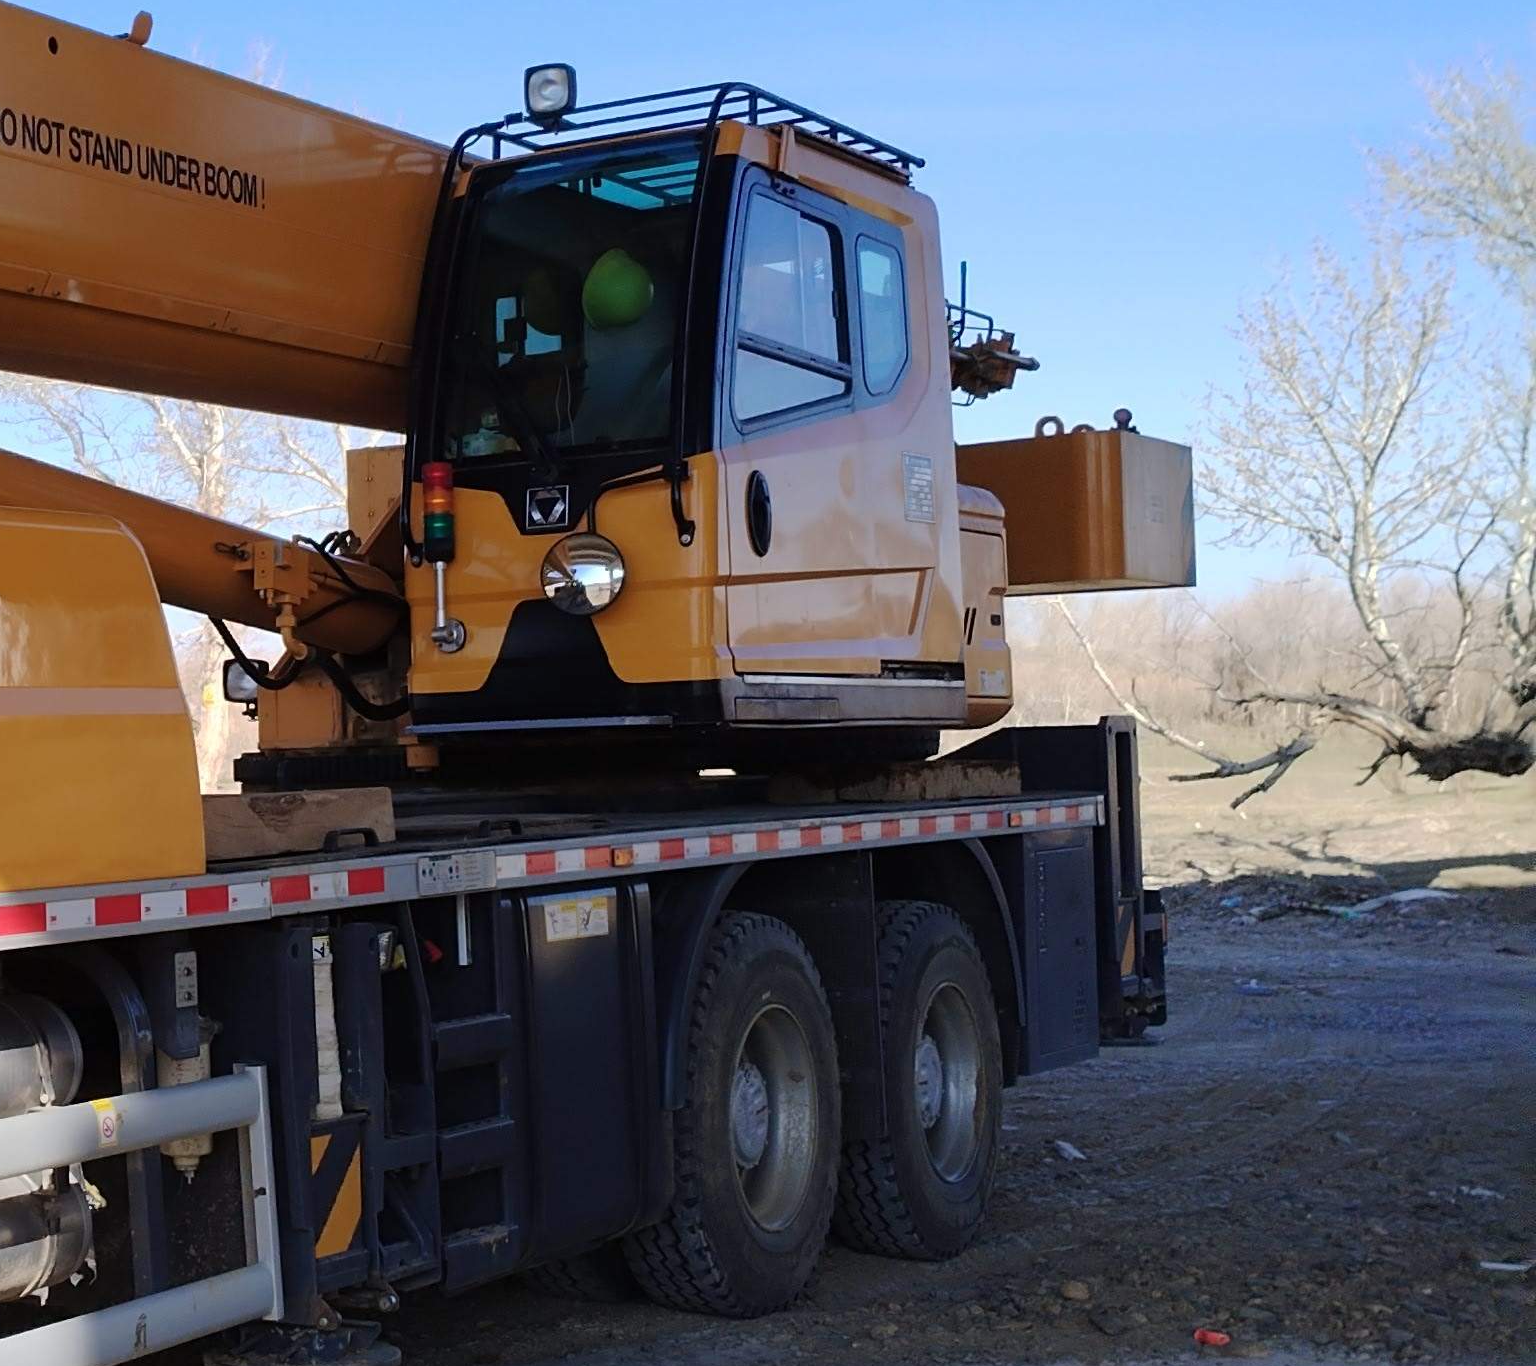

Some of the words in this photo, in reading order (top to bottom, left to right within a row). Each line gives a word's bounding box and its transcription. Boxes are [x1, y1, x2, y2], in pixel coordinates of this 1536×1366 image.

[21, 114, 65, 157] NOT
[69, 126, 133, 175] STAND
[137, 144, 202, 194] UNDER
